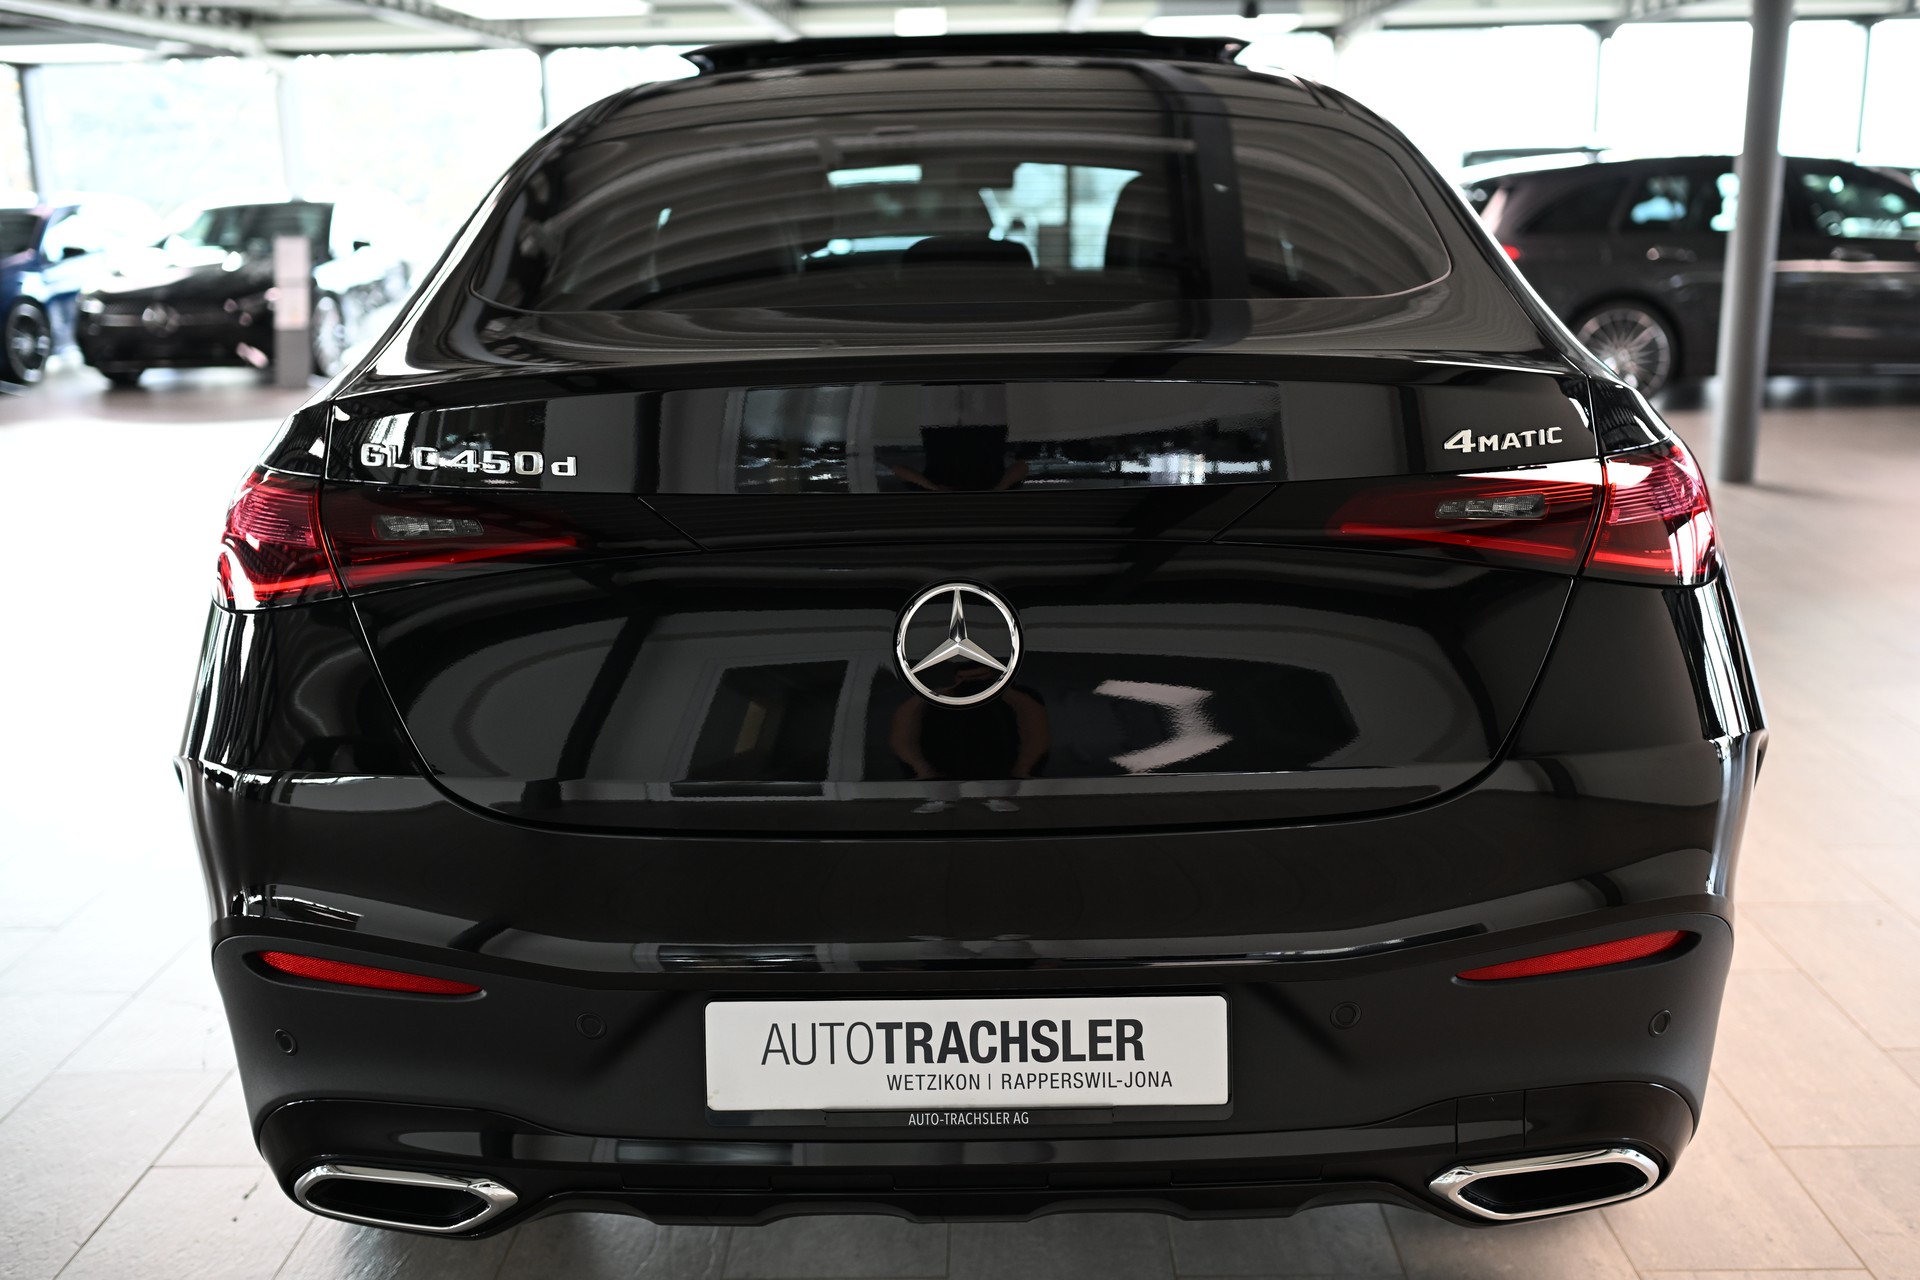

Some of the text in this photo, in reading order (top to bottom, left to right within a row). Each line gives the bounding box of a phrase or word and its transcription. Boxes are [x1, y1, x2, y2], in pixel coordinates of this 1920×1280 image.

[1444, 427, 1563, 453] 4MATIC
[361, 443, 439, 470] GLC
[887, 1074, 980, 1091] WETZIKON
[1001, 1071, 1173, 1090] RAPPERSWIL-JONA
[908, 1112, 1029, 1126] AUTO-TRACHSLER AG
